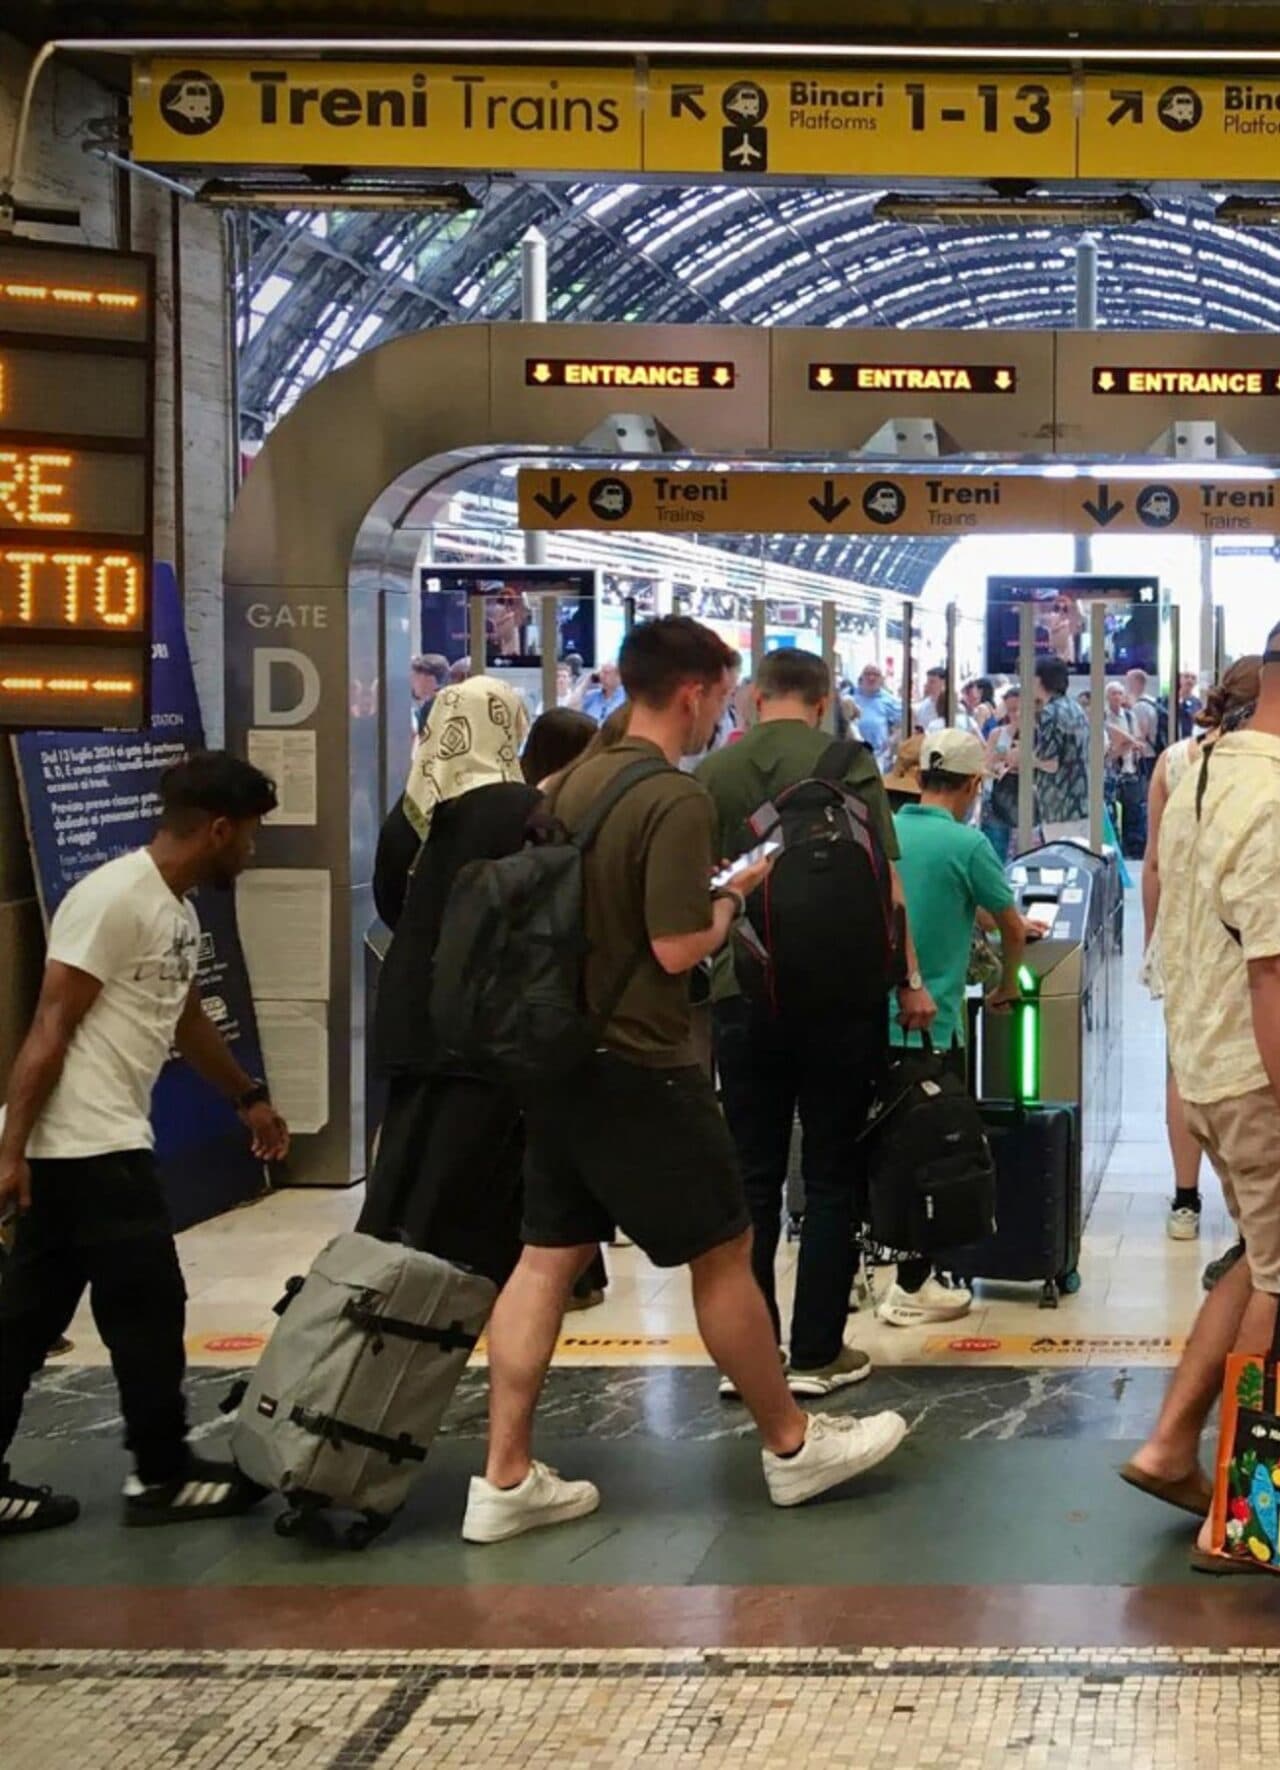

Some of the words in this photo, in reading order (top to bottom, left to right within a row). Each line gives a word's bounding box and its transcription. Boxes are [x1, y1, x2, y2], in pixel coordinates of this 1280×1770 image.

[249, 71, 428, 127] Treni
[452, 75, 619, 132] Trains
[790, 81, 884, 107] Binari
[904, 83, 1052, 134] 1-13
[790, 110, 878, 131] Platforms
[565, 366, 699, 386] ENTRANCE
[858, 369, 971, 389] ENTRATA
[1129, 372, 1262, 392] ENTRANCE
[653, 477, 728, 501] Treni
[925, 481, 1000, 504] Treni
[1201, 485, 1275, 508] Treni
[655, 506, 705, 523] Trains
[928, 508, 976, 525] Trains
[1202, 512, 1251, 529] Trains
[0, 551, 137, 624] TTO
[246, 603, 327, 629] GATE
[252, 647, 320, 726] D
